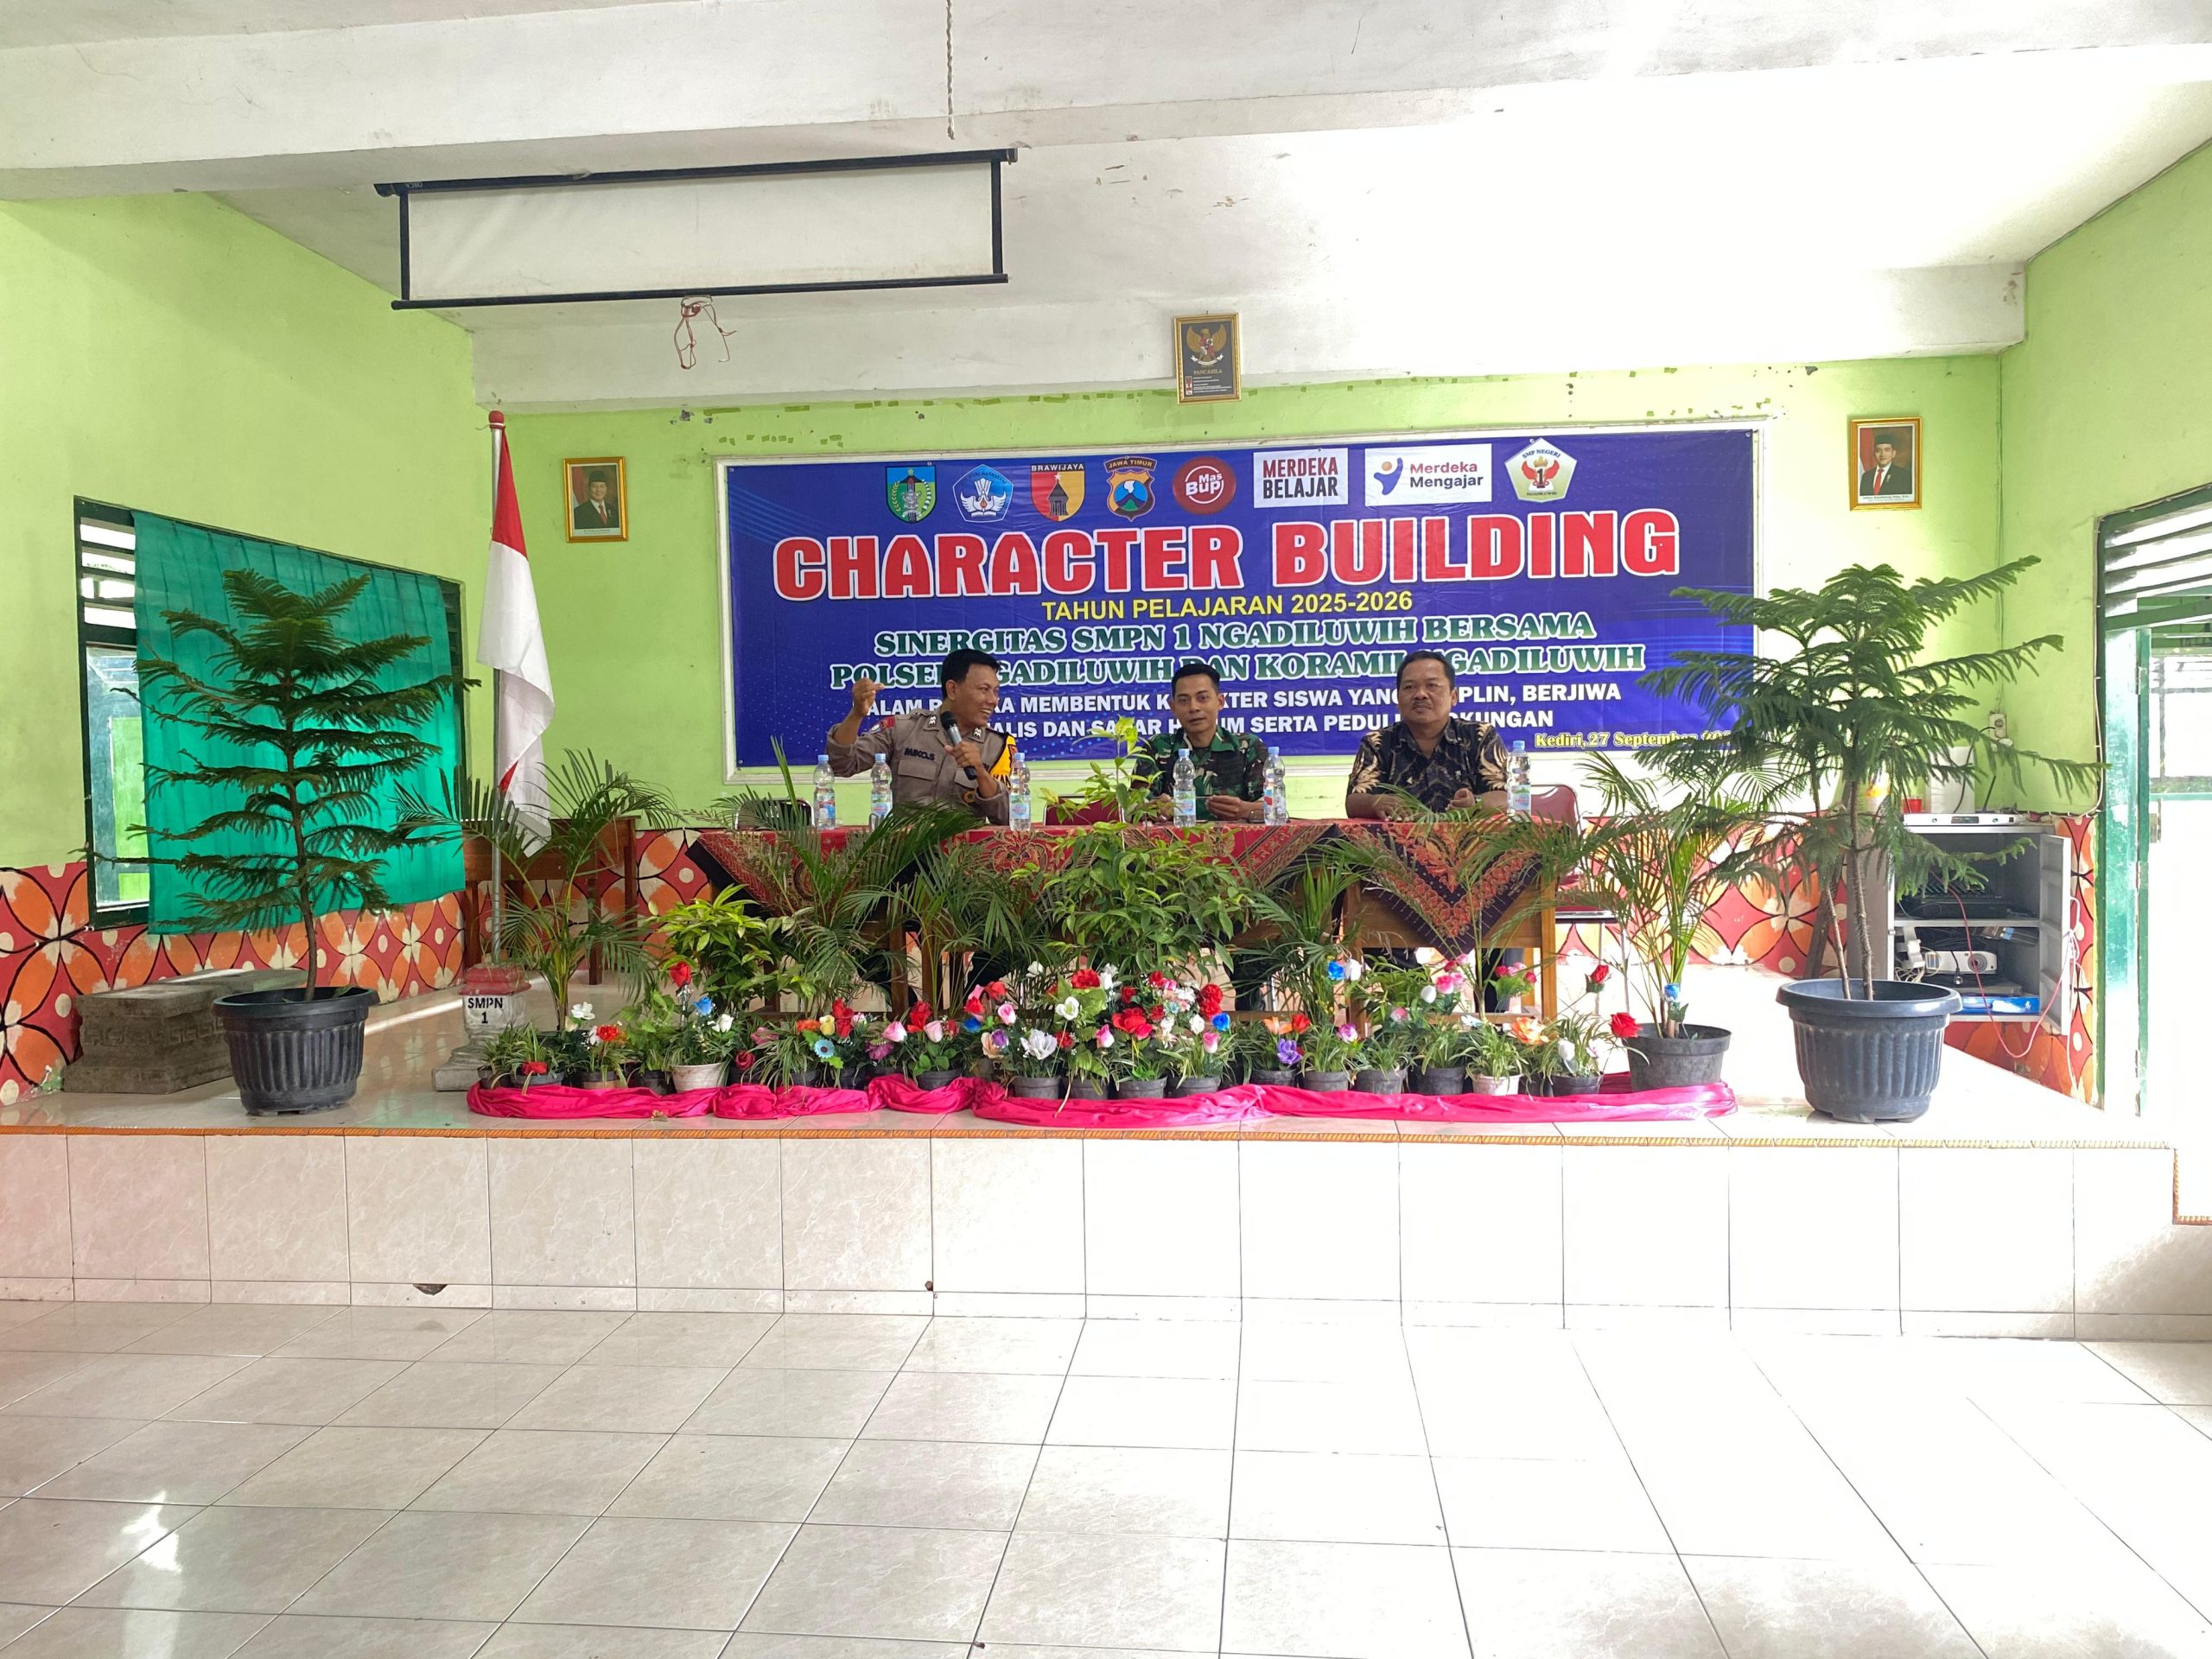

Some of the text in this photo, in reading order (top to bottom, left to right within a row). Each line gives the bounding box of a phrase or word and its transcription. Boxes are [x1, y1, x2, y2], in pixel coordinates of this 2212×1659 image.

[1522, 449, 1561, 459] SMP NEGERI
[1031, 463, 1084, 472] BRAWIJAYA
[1109, 460, 1128, 468] JAWA
[1262, 456, 1338, 478] MERDEKA
[1410, 461, 1478, 474] Merdeka
[1198, 473, 1223, 483] Mas
[1410, 474, 1484, 490] Mengajar
[1536, 468, 1545, 488] 1
[1185, 480, 1221, 496] Bup
[1262, 477, 1338, 499] BELAJAR
[773, 508, 1680, 601] CHARACTER BUILDING
[1041, 591, 1413, 620] TAHUN PELAJARAN 2025-2026
[874, 612, 1597, 658] SINERGITAS SMPN 1 NGADILUWIH BERSAMA
[996, 656, 1175, 687] GADILUWIH
[1419, 644, 1646, 676] GADILUWIH
[853, 698, 923, 716] ALAM
[1020, 694, 1151, 713] MEMBENTUK
[1273, 690, 1343, 708] SISWA
[1522, 683, 1622, 702] BERJIWA
[1043, 721, 1087, 738] DAN
[1091, 719, 1162, 735] SAAR
[1250, 715, 1319, 734] SERTA
[467, 997, 503, 1009] SMPN
[481, 1012, 488, 1024] 1
